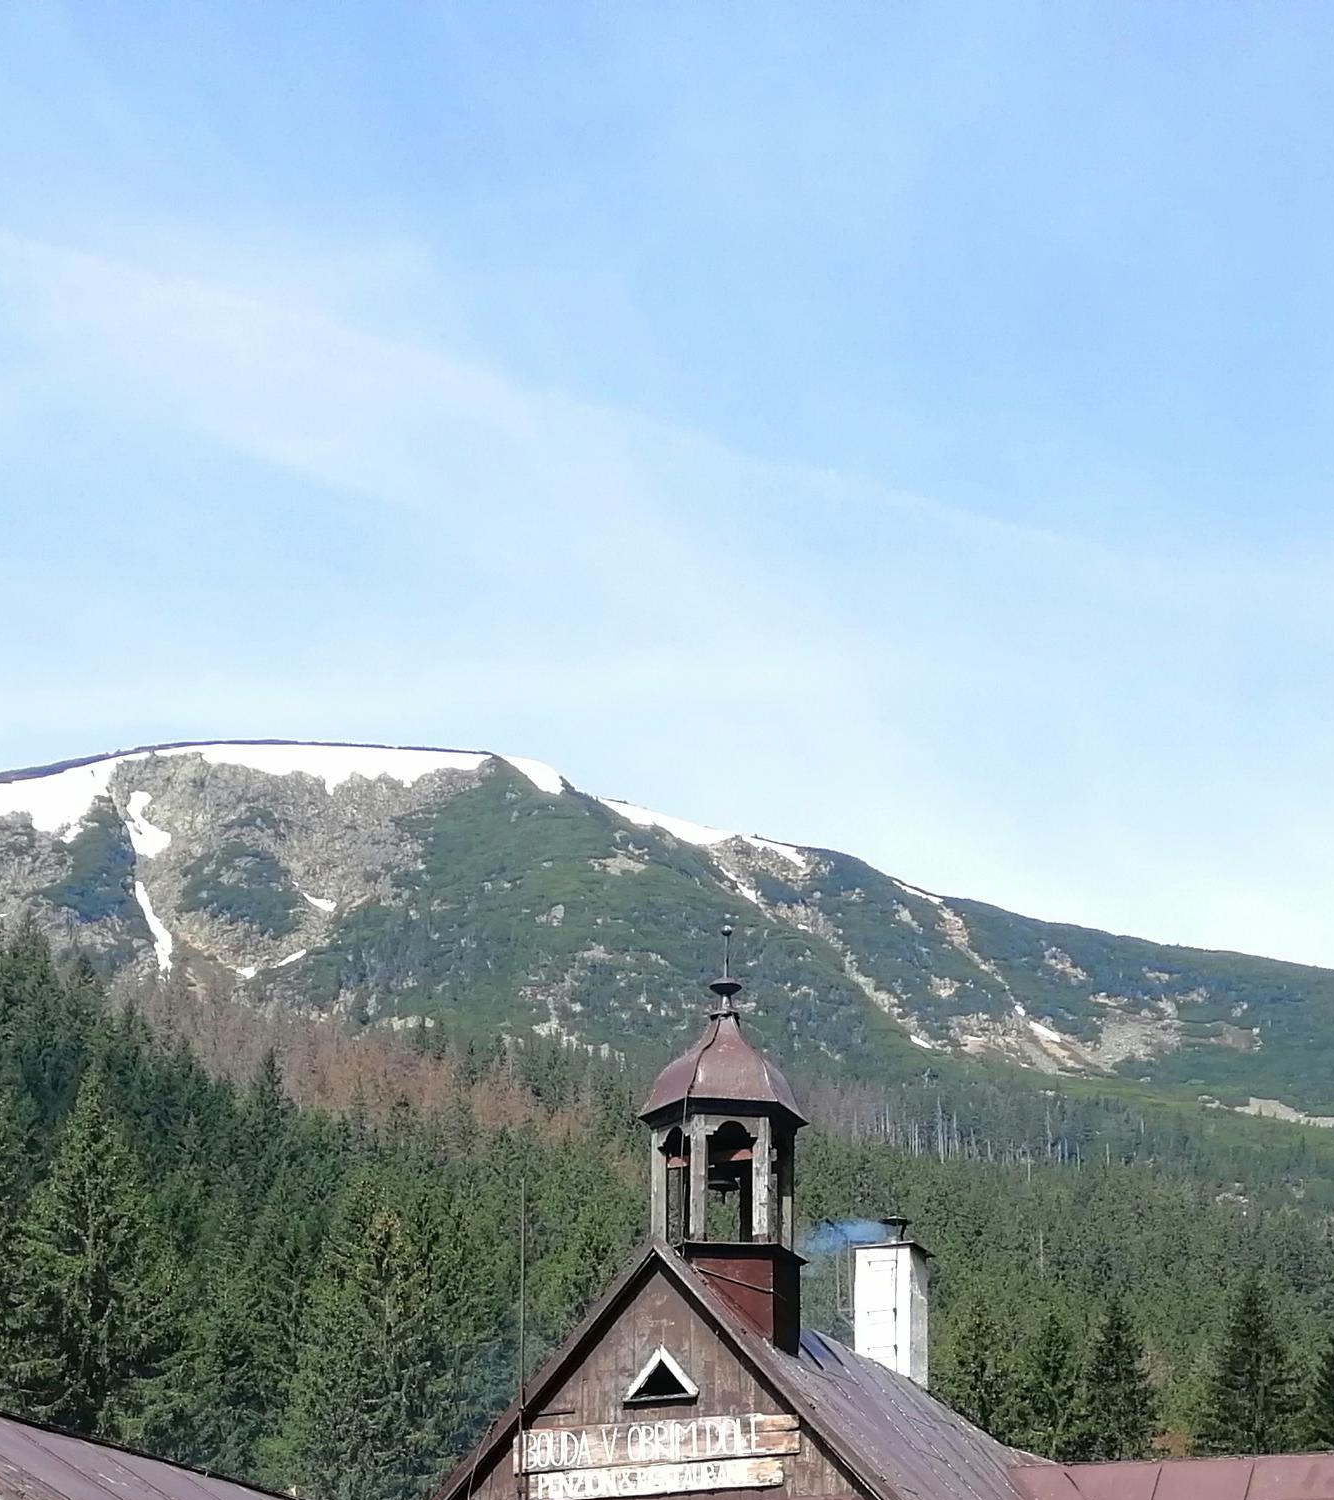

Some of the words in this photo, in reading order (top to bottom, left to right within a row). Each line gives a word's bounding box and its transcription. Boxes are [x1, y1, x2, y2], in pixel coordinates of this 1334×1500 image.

[522, 1430, 591, 1470] BOUDA
[602, 1427, 618, 1464] V
[705, 1414, 765, 1456] DOLE
[537, 1468, 618, 1500] PENZION
